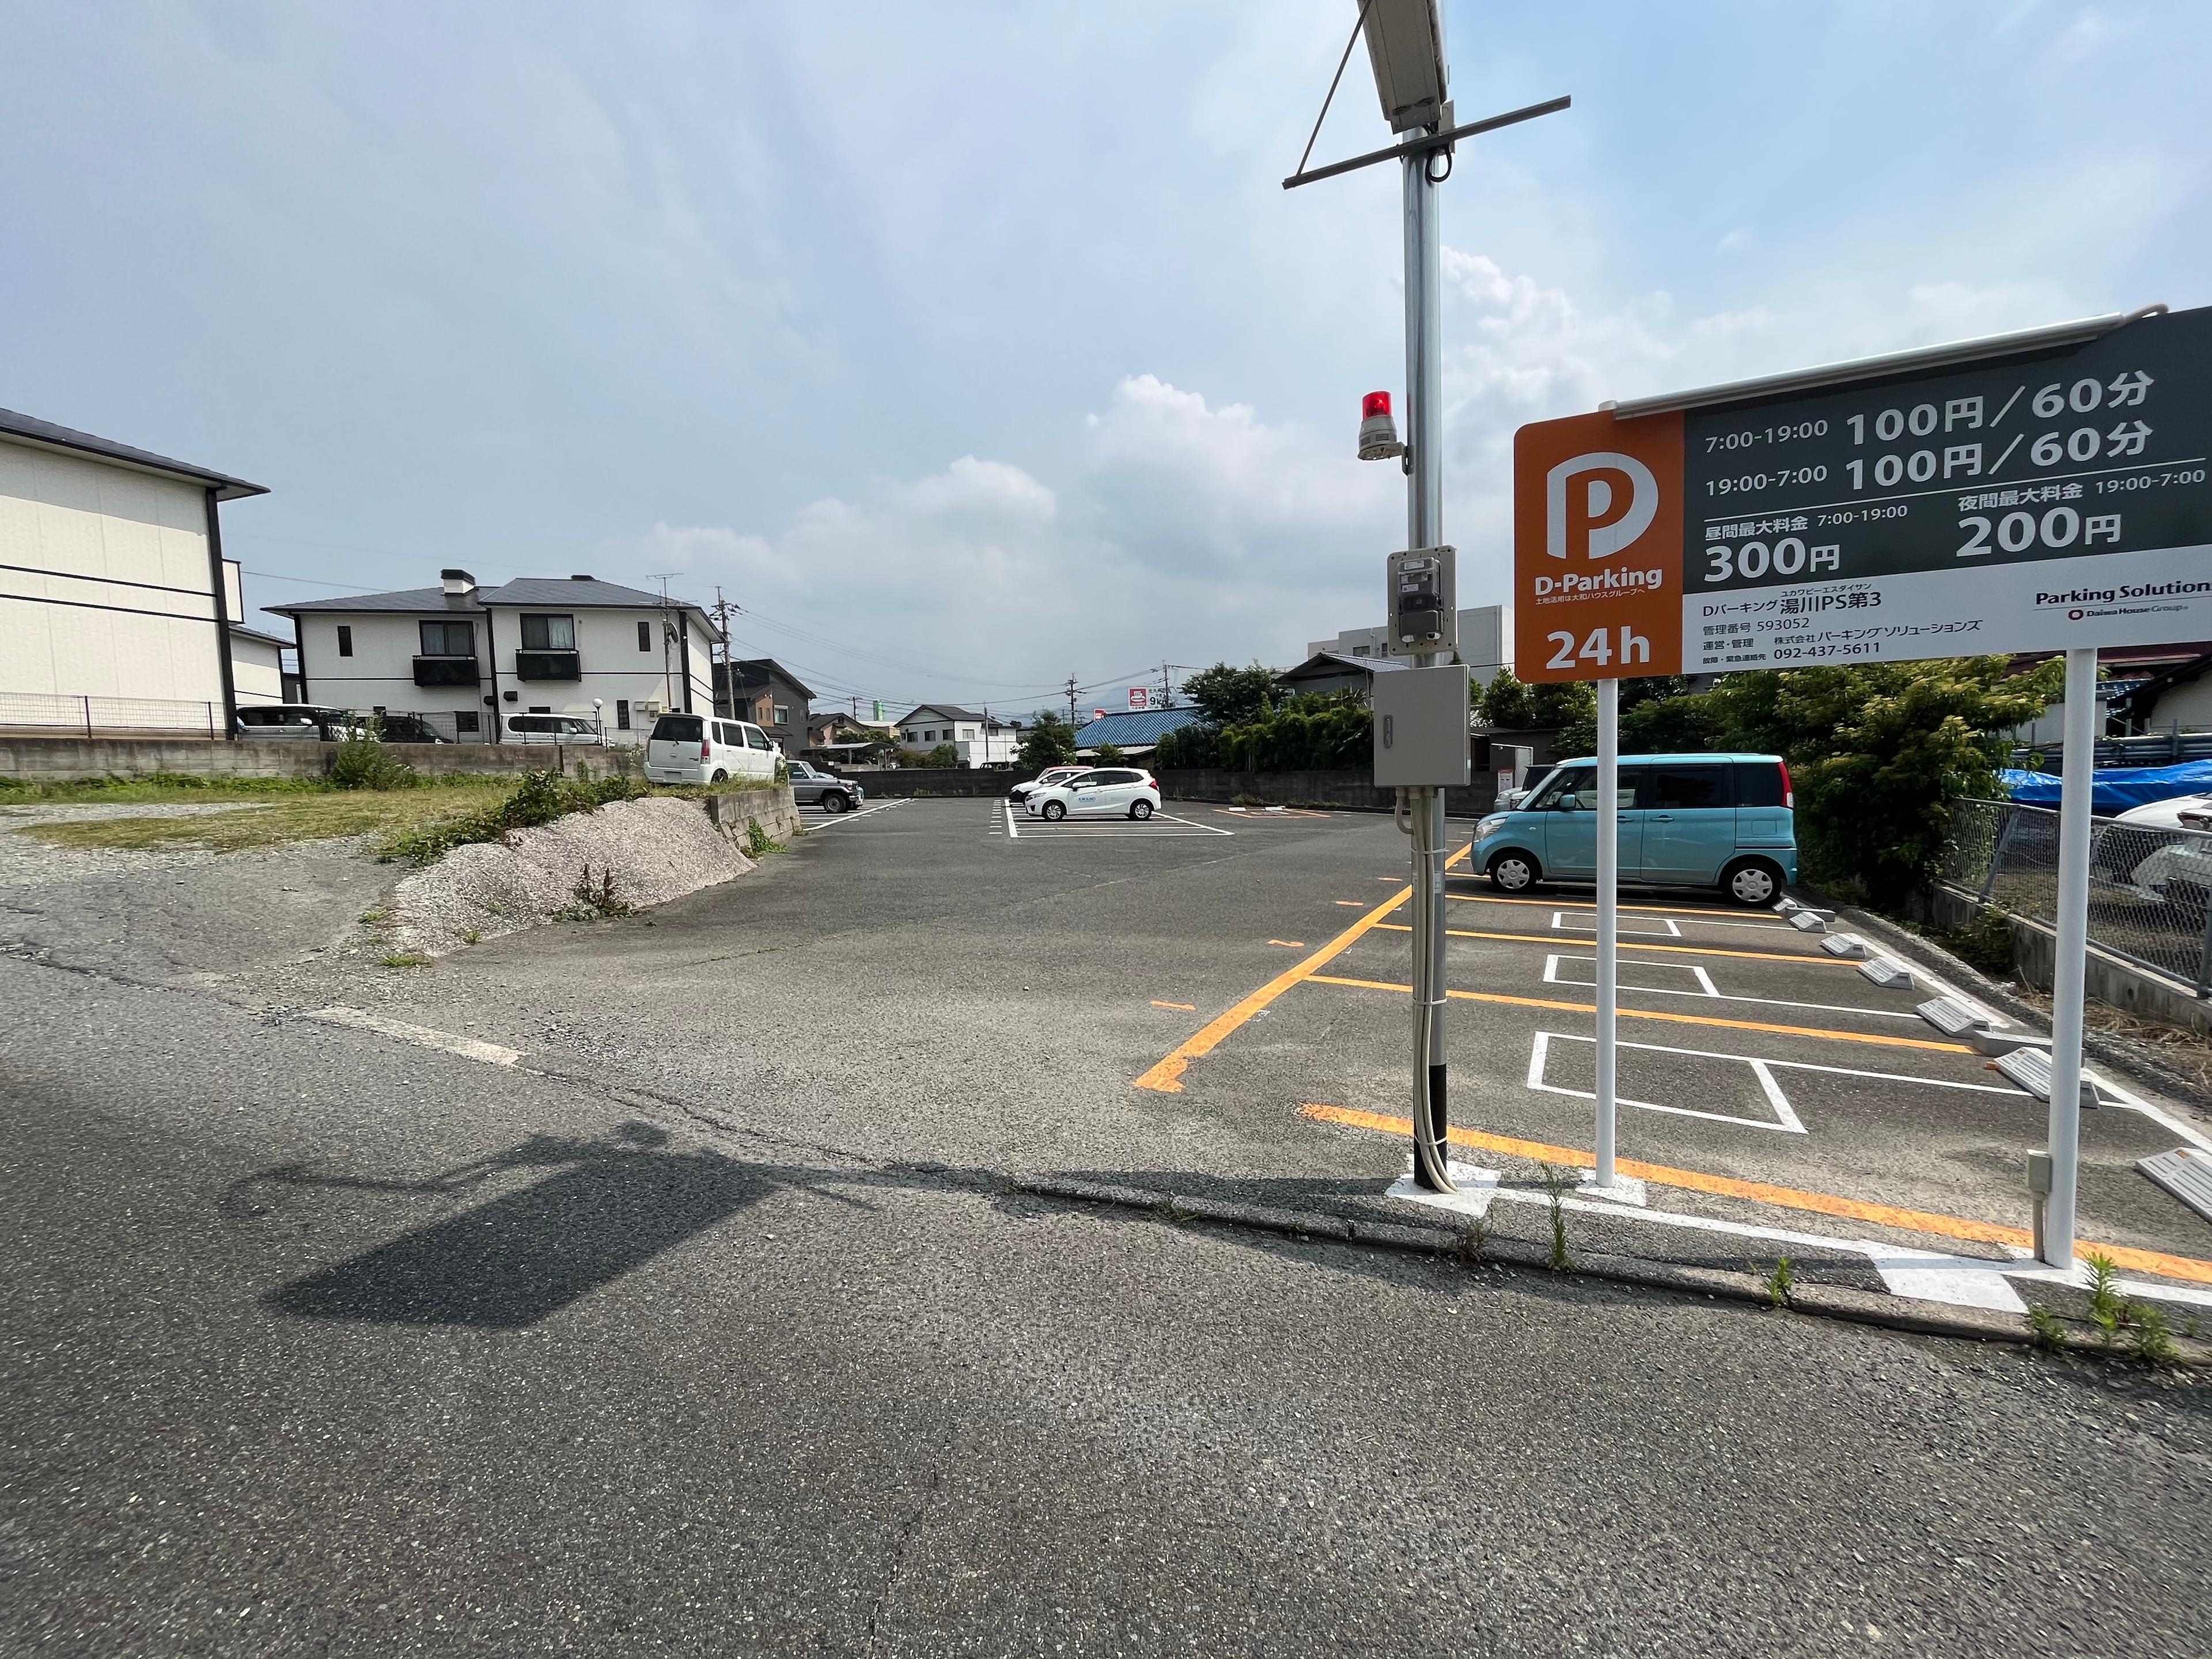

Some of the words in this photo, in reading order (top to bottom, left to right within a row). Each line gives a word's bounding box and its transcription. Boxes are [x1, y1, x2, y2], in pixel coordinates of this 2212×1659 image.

[1705, 419, 1828, 453] 7:00-19:00
[1706, 464, 1828, 496] 19:00-7:00
[1959, 482, 2084, 512] 夜間最大料金
[2096, 469, 2206, 494] 19:00-7:00
[1705, 515, 1809, 541] 昼間最大料金
[1817, 505, 1908, 527] 7:00-19:00
[1956, 506, 2122, 557] 200円
[1704, 537, 1840, 582] 300円
[1535, 566, 1663, 596] D-Parking
[2036, 588, 2116, 605] Parking
[2119, 580, 2212, 599] Solution
[1703, 622, 1751, 636] 管理番号
[1756, 617, 1810, 631] 593052
[2119, 606, 2150, 615] House
[1546, 625, 1650, 669] 24h
[1703, 638, 1754, 651] 運営・管理
[1774, 642, 1880, 660] 092-437-5611
